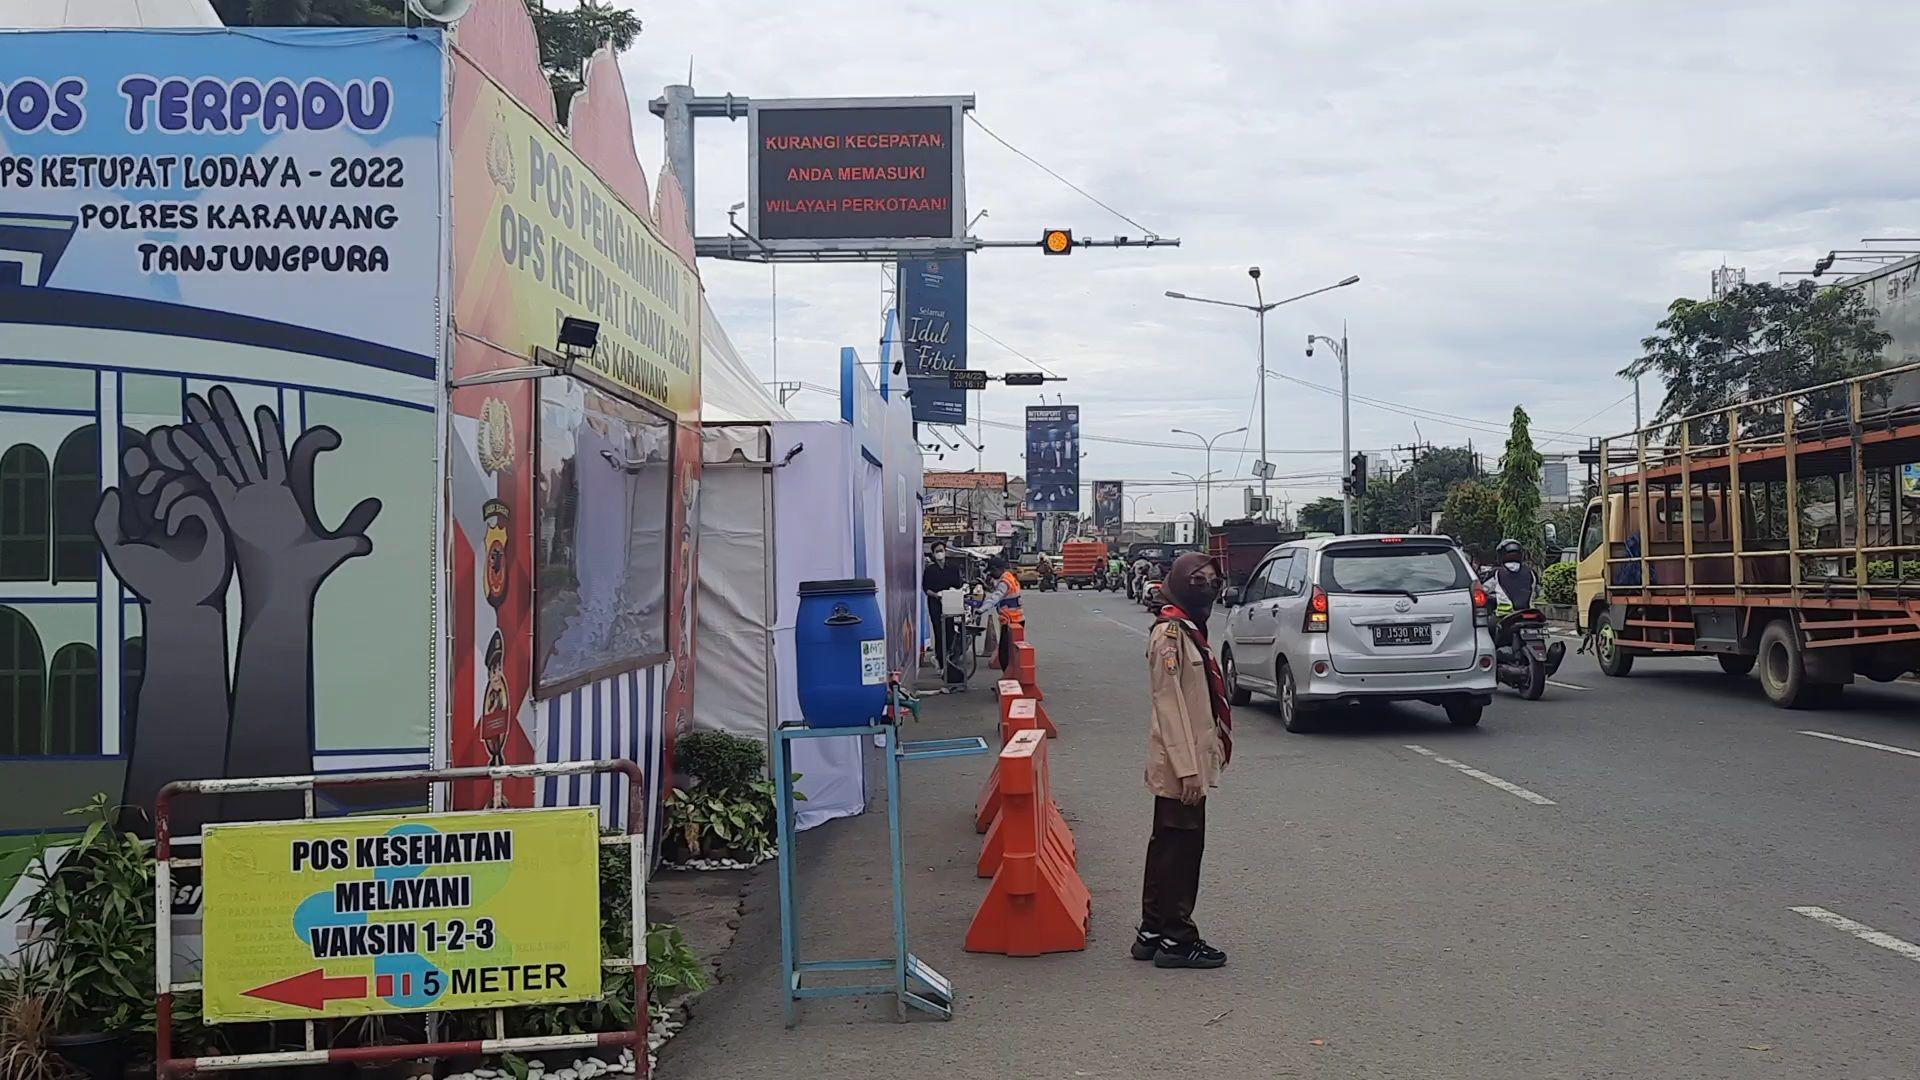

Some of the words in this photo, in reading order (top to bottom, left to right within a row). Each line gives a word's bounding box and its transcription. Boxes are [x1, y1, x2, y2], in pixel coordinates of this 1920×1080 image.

[0, 79, 84, 132] OS
[121, 79, 391, 132] TERPADU
[766, 136, 840, 150] KURANGI
[845, 133, 945, 149] KECEPATAN,
[41, 157, 176, 188] KETUPAT
[184, 156, 301, 188] LODAYA
[330, 157, 404, 188] 2022
[787, 168, 833, 181] ANDA
[838, 166, 925, 181] MEMASUKI
[81, 204, 198, 230] POLRES
[207, 204, 398, 230] KARAWANG
[766, 199, 837, 213] WILAYAH
[529, 135, 574, 230] POS
[580, 180, 678, 316] PENGAMANAN
[138, 243, 389, 272] TANJUNGPURA
[500, 204, 545, 283] OPS
[551, 236, 620, 329] KETUPAT
[624, 290, 667, 359] LODAYA
[669, 326, 690, 375] 2022
[919, 306, 945, 318] Selamat
[908, 317, 950, 344] Idul
[612, 343, 668, 402] KARAWANG
[914, 345, 956, 370] Fitri
[1376, 628, 1381, 639] B
[293, 841, 348, 871] POS
[356, 831, 511, 867] KESEHATAN
[336, 877, 470, 913] MELAYANI
[311, 923, 415, 958] VAKSIN
[421, 918, 495, 952] 1-2-3
[423, 970, 440, 996] 5
[452, 963, 568, 994] METER
